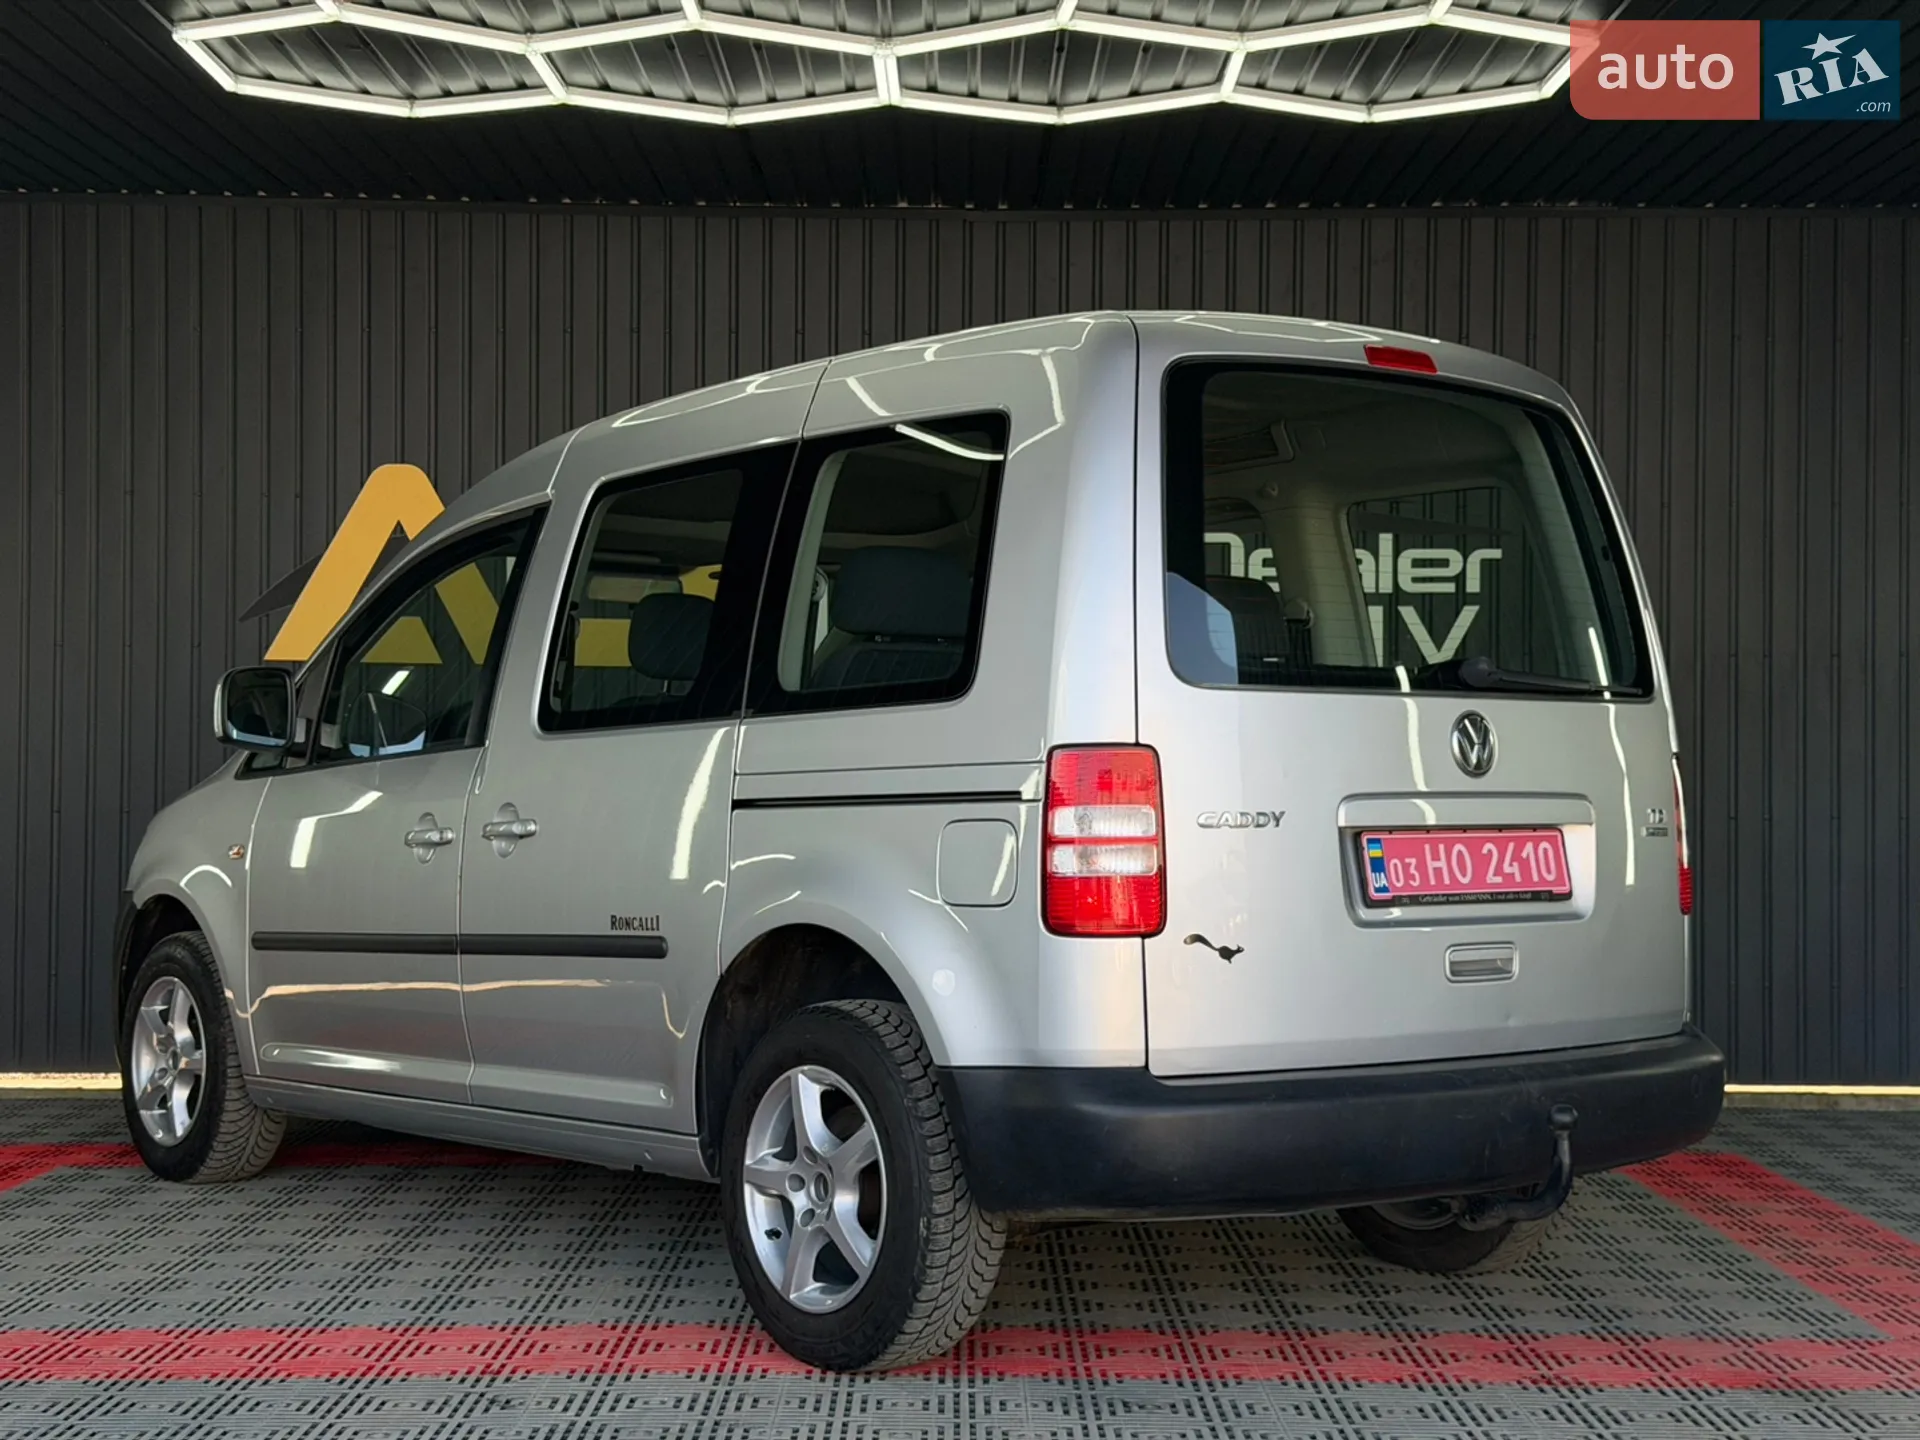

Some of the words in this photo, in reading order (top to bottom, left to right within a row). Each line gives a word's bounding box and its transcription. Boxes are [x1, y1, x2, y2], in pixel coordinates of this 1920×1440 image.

[1197, 811, 1286, 829] CADDY
[1371, 871, 1388, 888] UA
[1389, 857, 1421, 888] 03
[1424, 843, 1473, 886] HO
[1481, 840, 1557, 884] 2410
[610, 914, 660, 931] RONCALLI
